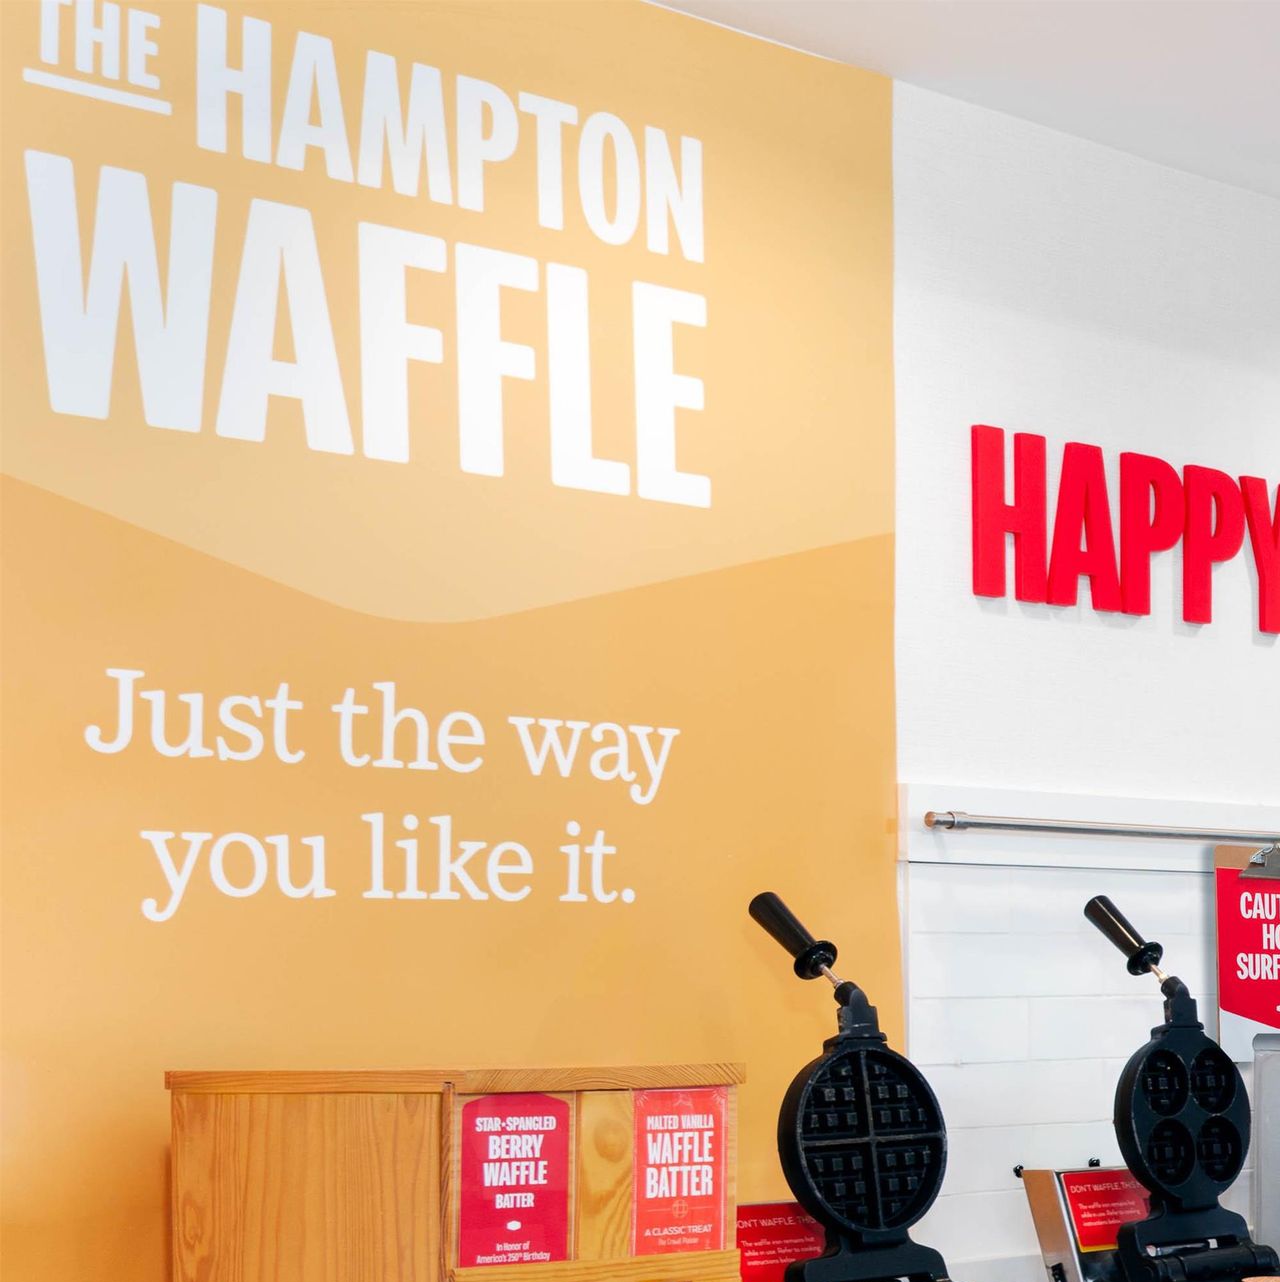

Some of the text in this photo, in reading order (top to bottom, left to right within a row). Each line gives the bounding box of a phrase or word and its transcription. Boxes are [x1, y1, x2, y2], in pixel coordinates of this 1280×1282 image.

[39, 0, 705, 264] THE HAMPTON
[24, 149, 712, 509] WAFFLE
[84, 668, 680, 805] Just the way
[140, 812, 637, 922] you like it.
[646, 1114, 714, 1130] MALTED VANILLA
[488, 1134, 544, 1159] BERRY
[646, 1131, 714, 1165] WAFFLE
[483, 1161, 548, 1187] WAFFLE
[645, 1165, 714, 1198] BATTER
[495, 1193, 535, 1209] BATTER
[652, 1226, 686, 1236] CLASSIC
[688, 1224, 712, 1233] TREAT
